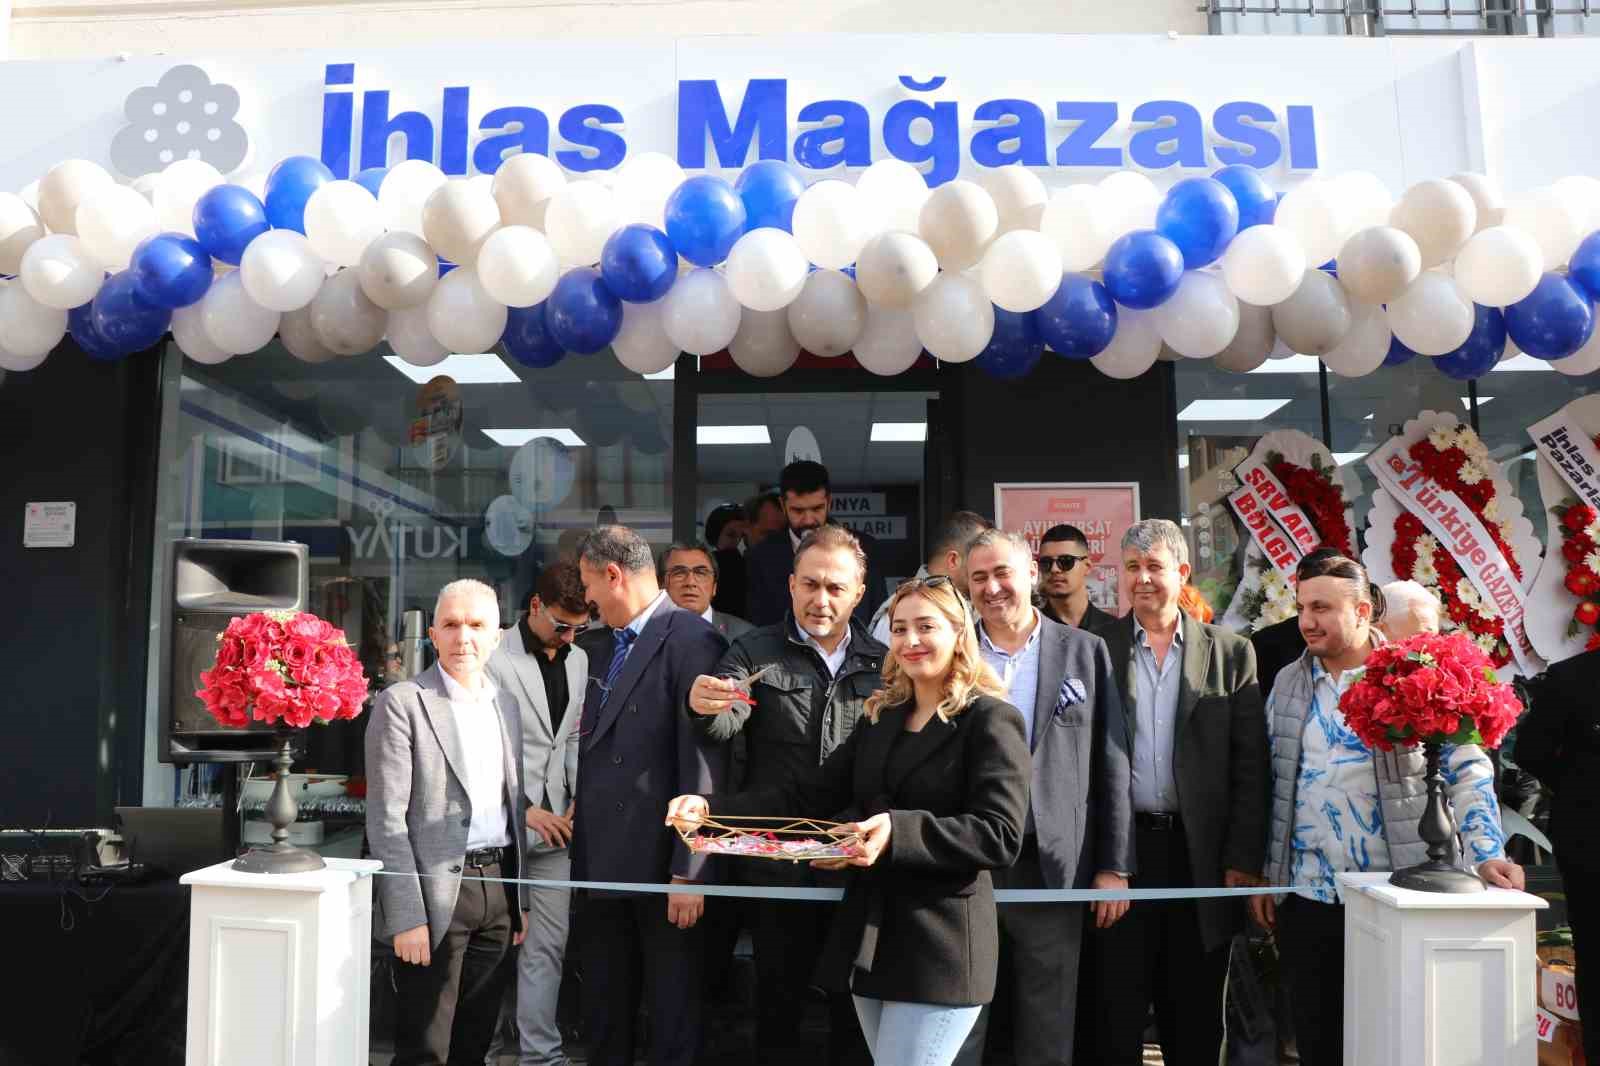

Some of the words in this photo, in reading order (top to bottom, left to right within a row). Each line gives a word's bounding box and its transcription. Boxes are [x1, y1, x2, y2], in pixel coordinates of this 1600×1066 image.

[321, 63, 627, 180] İhlas
[677, 75, 1319, 189] Mağazası
[1234, 492, 1297, 570] BÖLGE
[1245, 467, 1290, 511] SRV
[1398, 463, 1486, 567] Türkiye
